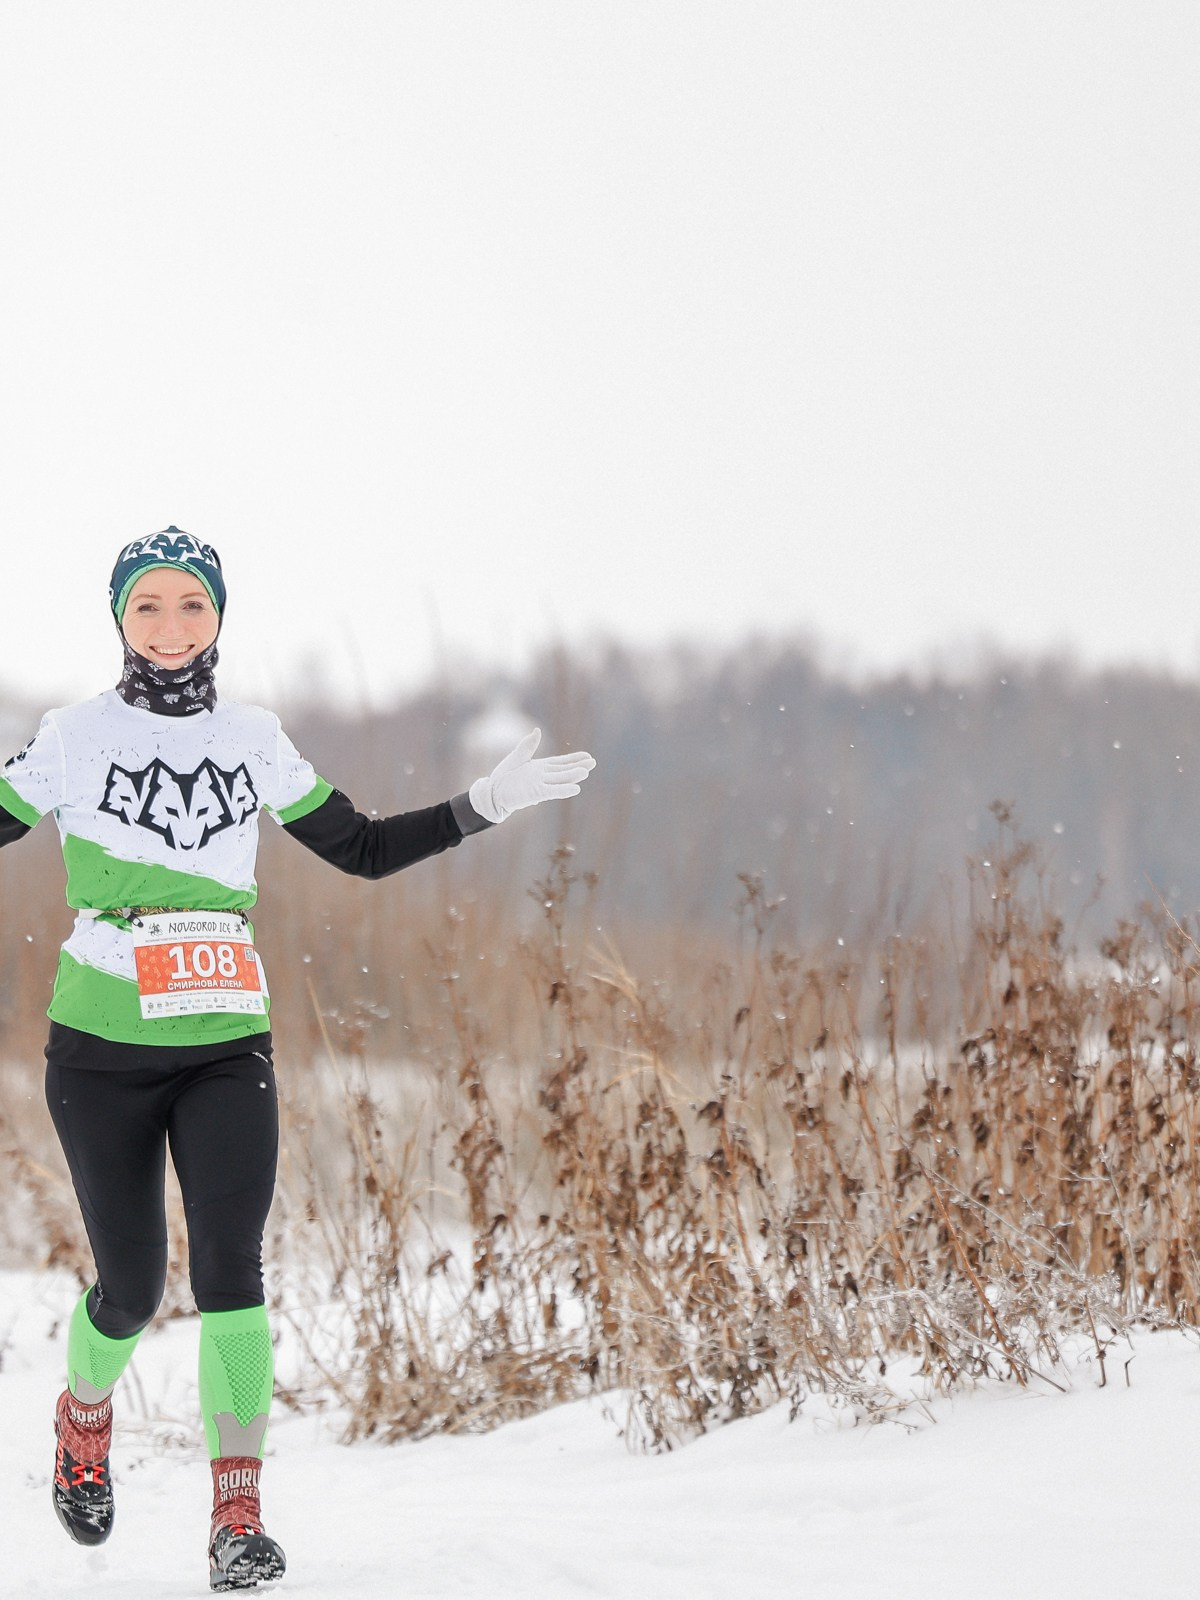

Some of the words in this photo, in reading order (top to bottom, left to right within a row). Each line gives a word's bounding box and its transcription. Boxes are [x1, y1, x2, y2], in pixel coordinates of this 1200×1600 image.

[169, 921, 217, 933] NOVGOROD
[220, 922, 231, 934] ICE
[169, 944, 238, 979] 108
[167, 979, 218, 991] СМИРНОВА
[219, 979, 243, 988] ЕЛЕНА
